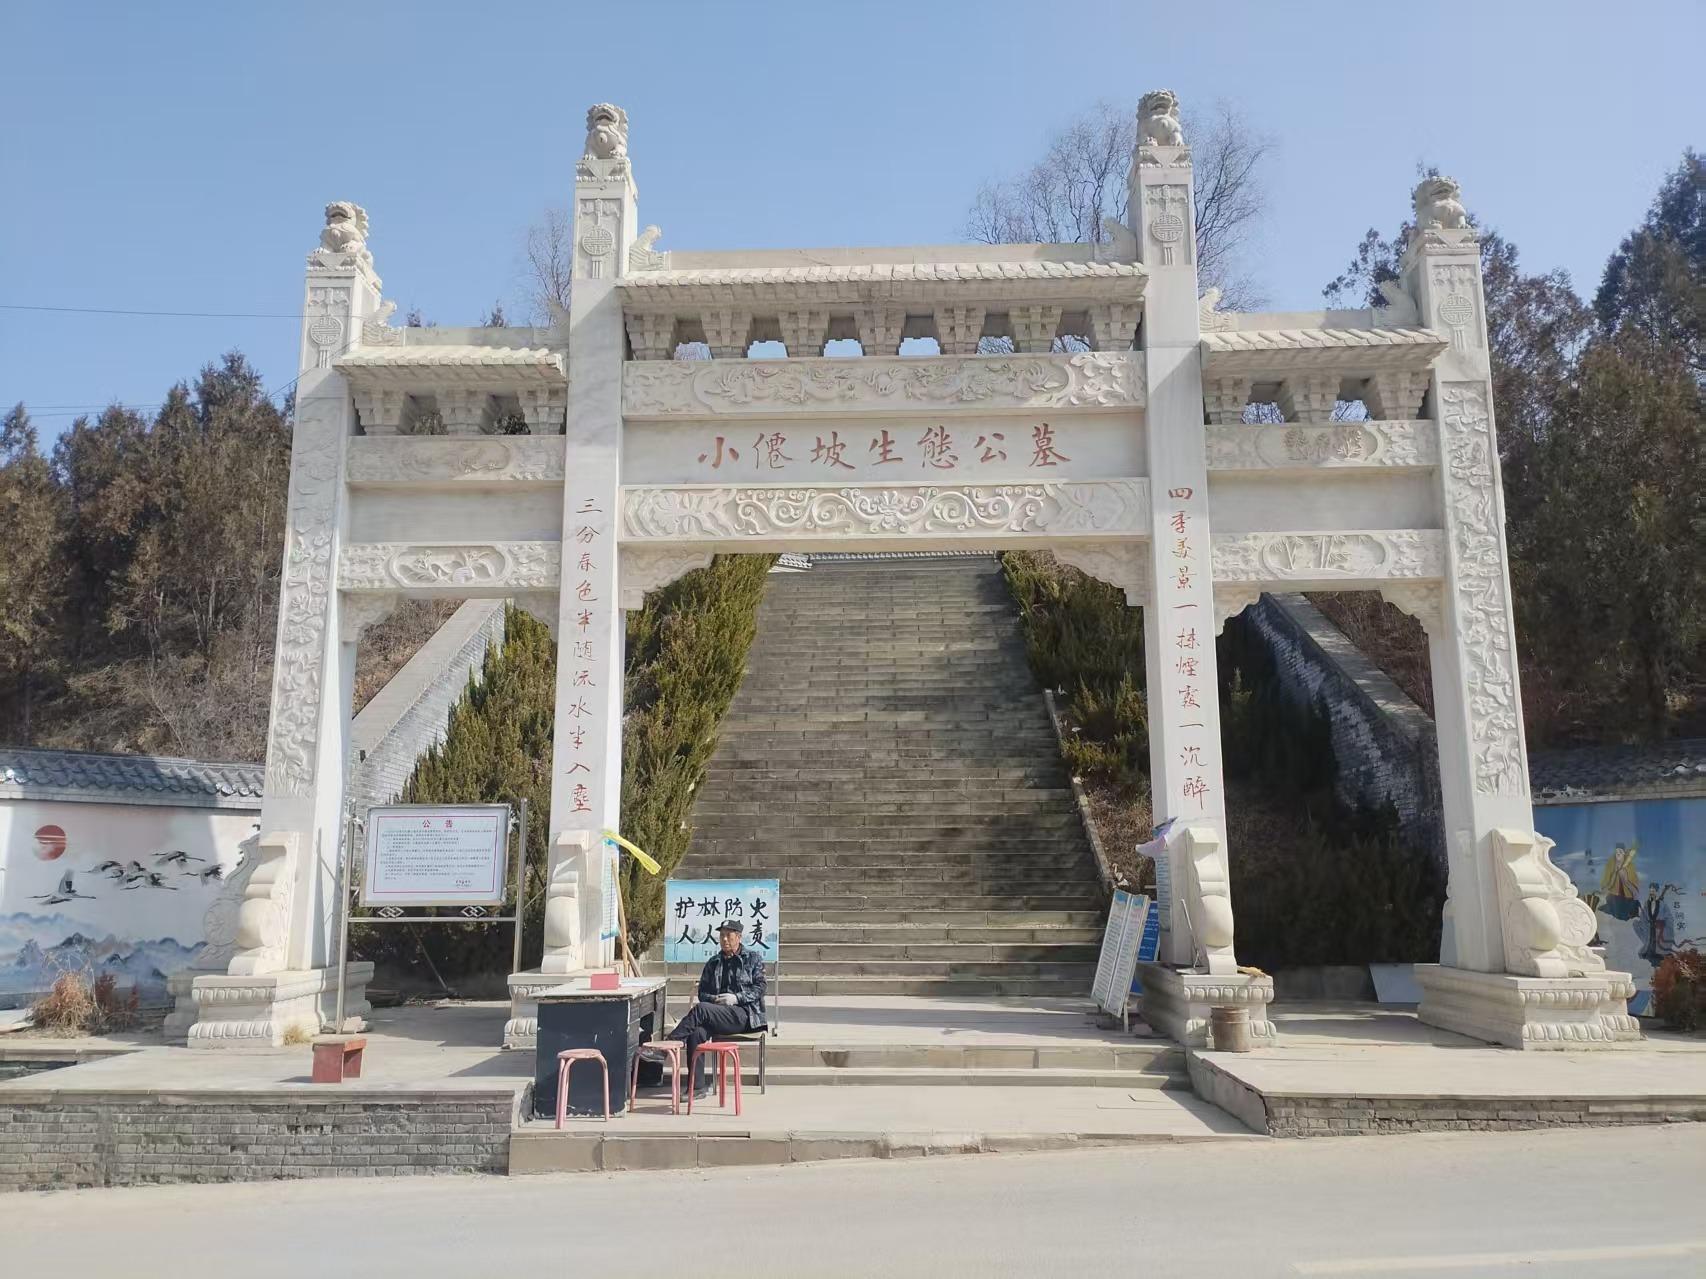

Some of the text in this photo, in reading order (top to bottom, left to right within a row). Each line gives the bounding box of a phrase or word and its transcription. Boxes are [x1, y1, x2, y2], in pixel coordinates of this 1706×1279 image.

[674, 896, 770, 920] 护林防火
[675, 919, 771, 950] 人人责
